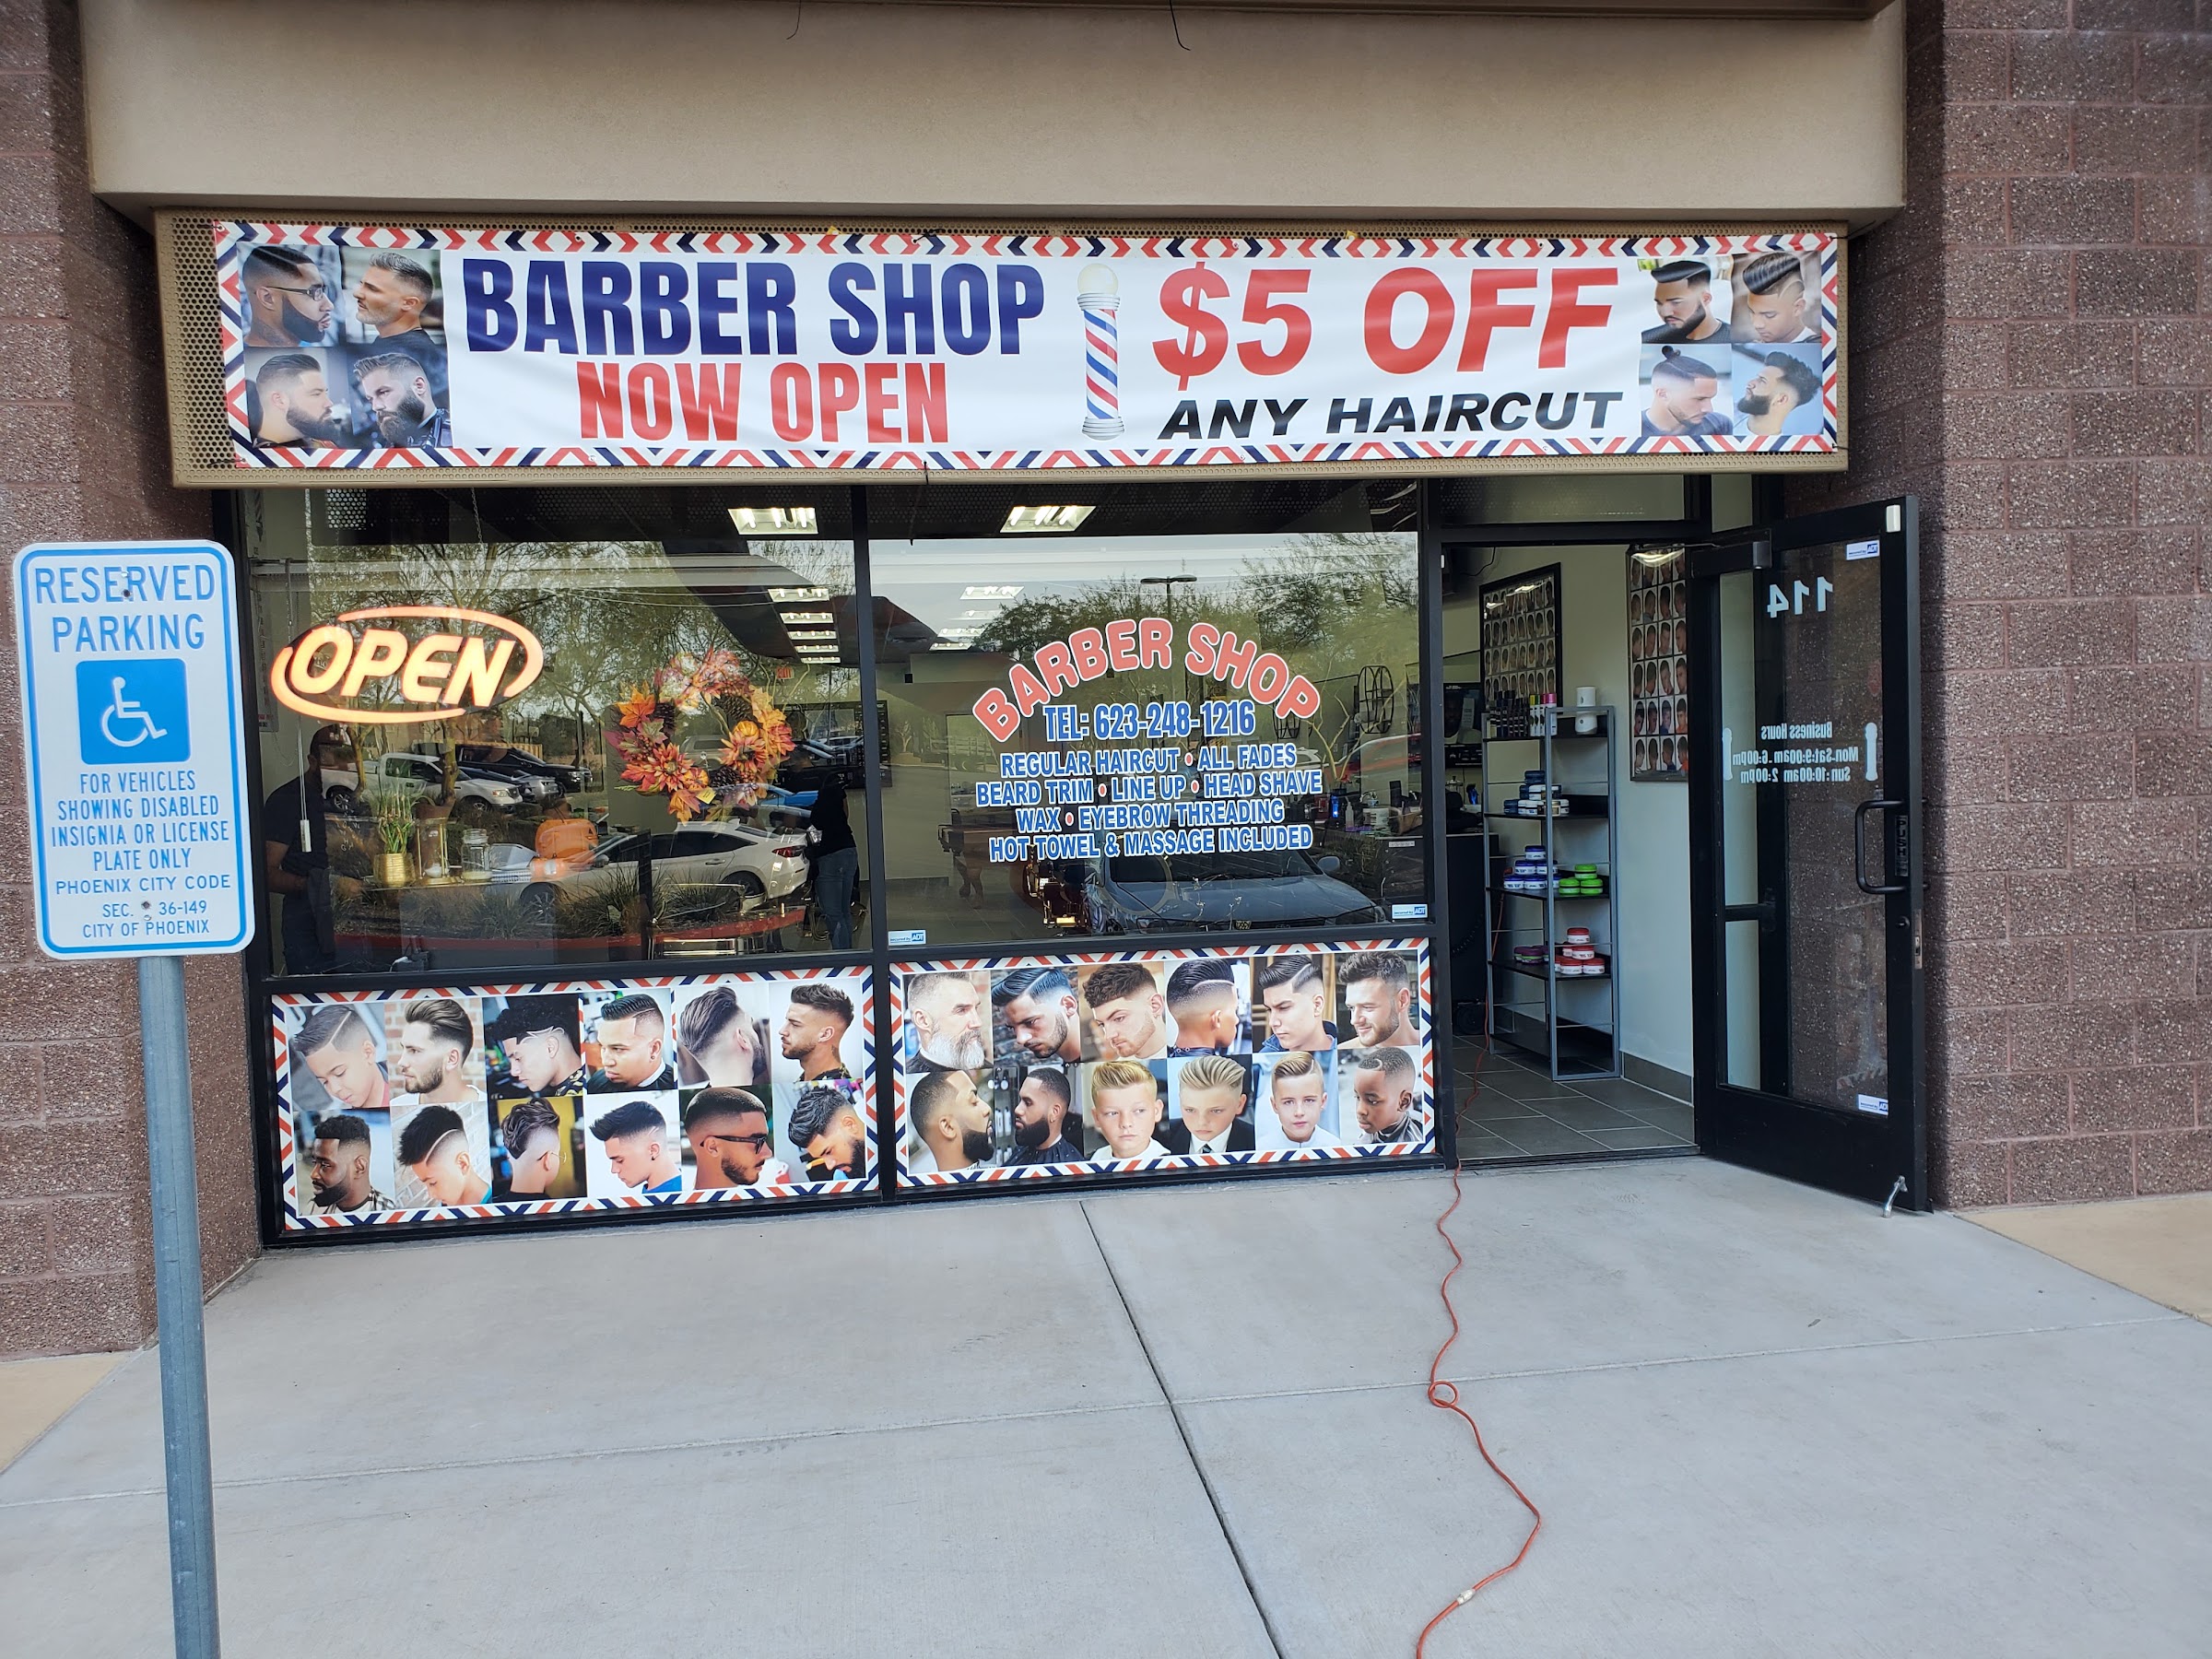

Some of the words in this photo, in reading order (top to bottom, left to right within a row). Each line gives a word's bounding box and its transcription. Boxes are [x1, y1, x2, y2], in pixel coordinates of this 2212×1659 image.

[463, 258, 797, 357] BARBER
[830, 261, 1045, 358] SHOP
[1152, 261, 1312, 392] $5
[1363, 266, 1619, 376] OFF
[577, 360, 741, 441] NOW
[771, 361, 948, 446] OPEN
[1157, 397, 1312, 441] ANY
[1326, 391, 1624, 435] HAIRCUT
[35, 564, 216, 605] RESERVED
[53, 613, 206, 653] PARKING
[289, 625, 516, 708] OPEN
[972, 617, 1173, 743] BARBER
[1184, 622, 1321, 720] SHOP
[1043, 705, 1089, 742] TEL:
[1094, 700, 1256, 740] 623-248-1216
[1000, 751, 1092, 778] REGULAR
[1096, 747, 1180, 773] HAIRCUT
[1197, 746, 1234, 771] ALL
[1238, 743, 1297, 769] FADES
[80, 772, 112, 794] FOR
[118, 770, 196, 793] VEHICLES
[976, 781, 1042, 806] BEARD
[1047, 779, 1094, 804] TRIM
[1112, 776, 1156, 802] LINE
[1160, 775, 1187, 800] UP
[1204, 772, 1256, 798] HEAD
[1260, 770, 1323, 795] SHAVE
[57, 798, 134, 821] SHOWING
[142, 794, 219, 818] DISABLED
[1016, 807, 1062, 832] WAX
[1078, 804, 1171, 830] EYEBROW
[1175, 798, 1285, 827] THREADING
[52, 824, 127, 847] INSIGNIA
[134, 823, 156, 843] OR
[162, 820, 229, 843] LICENSE
[989, 837, 1031, 863] HOT
[1034, 832, 1100, 860] TOWEL
[1105, 832, 1121, 857] &
[1124, 829, 1216, 856] MASSAGE
[1218, 823, 1313, 852] INCLUDED
[1897, 818, 1906, 856] PUSH
[93, 850, 142, 872] PLATE
[149, 847, 192, 870] ONLY
[56, 878, 132, 895] PHOENIX
[139, 877, 177, 892] CITY
[184, 874, 231, 890] CODE
[102, 903, 134, 918] SEC.
[159, 900, 207, 915] 36-149
[1415, 906, 1426, 915] ADT
[82, 923, 114, 938] CITY
[121, 922, 139, 936] OF
[146, 919, 210, 935] PHOENIX
[912, 932, 924, 941] ADT
